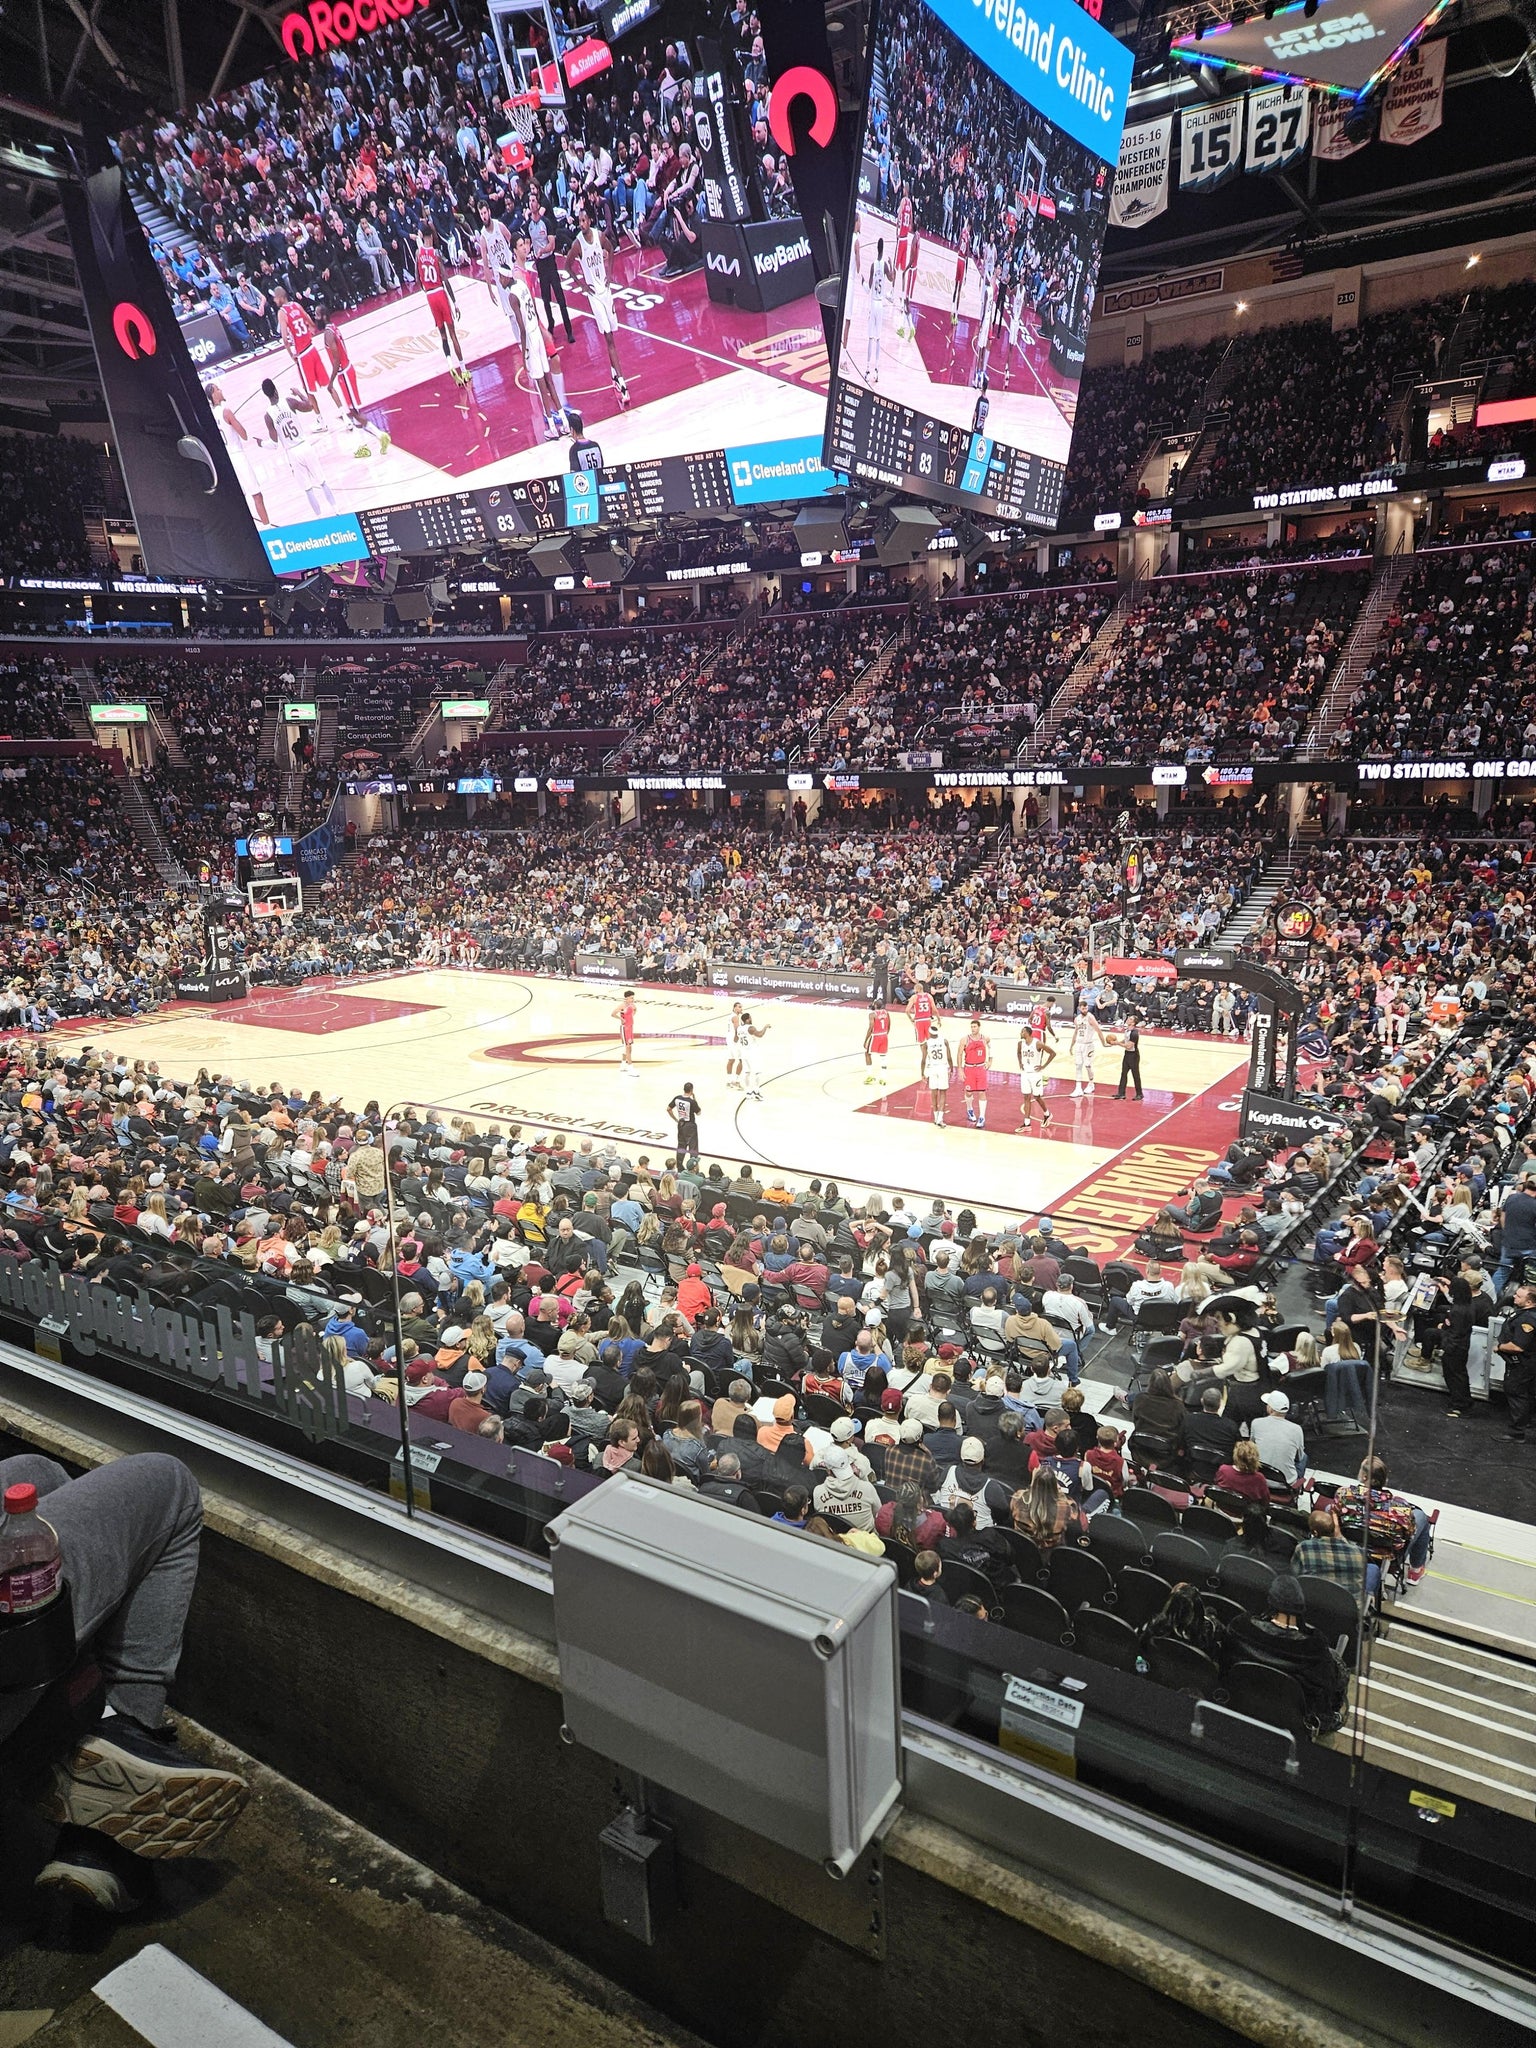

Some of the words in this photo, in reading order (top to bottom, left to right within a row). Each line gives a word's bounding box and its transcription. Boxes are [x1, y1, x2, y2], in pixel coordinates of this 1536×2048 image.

[1264, 23, 1317, 48] LET
[1320, 12, 1370, 36] EM
[1272, 24, 1387, 60] KNOW.
[1056, 36, 1115, 122] Clinic
[1402, 66, 1425, 83] EAST
[1392, 76, 1433, 98] DIVISION
[1385, 88, 1440, 111] CHAMPIONS
[1186, 106, 1238, 130] CALLANDER
[1120, 128, 1162, 150] 2015-16
[1254, 105, 1304, 159] 27
[1120, 146, 1161, 166] WESTERN
[1190, 123, 1232, 174] 15
[714, 101, 735, 175] Cleveland
[727, 174, 744, 217] Clinic
[1114, 173, 1163, 196] CHAMPIONS
[753, 236, 812, 275] KeyBank
[421, 264, 438, 283] 20
[1338, 293, 1355, 304] 210
[292, 318, 308, 338] 33
[1127, 335, 1141, 346] 209
[1420, 386, 1434, 394] 210
[1463, 380, 1477, 388] 211
[281, 420, 300, 442] 45
[939, 429, 949, 445] 3Q
[960, 435, 970, 452] 24
[752, 458, 804, 480] Cleveland
[919, 452, 933, 476] 83
[878, 470, 904, 487] RAFFLE
[943, 467, 957, 486] 1:51
[969, 469, 981, 490] 77
[512, 488, 527, 501] 3Q
[547, 480, 560, 495] 24
[1253, 494, 1279, 509] TWO
[1278, 487, 1338, 507] STATIONS.
[1338, 484, 1362, 499] ONE
[1362, 478, 1399, 497] GOAL.
[572, 502, 591, 521] 77
[497, 514, 515, 532] 83
[534, 513, 555, 530] 1:51
[285, 534, 332, 555] Cleveland
[327, 530, 358, 547] Clinic
[665, 570, 683, 581] TWO
[683, 566, 717, 581] STATIONS.
[716, 564, 732, 577] ONE
[731, 561, 751, 574] GOAL.
[20, 579, 43, 589] LET
[43, 580, 59, 590] EM
[59, 580, 103, 590] KNOW.
[112, 582, 134, 593] TWO
[134, 582, 180, 594] STATIONS.
[461, 582, 478, 592] ONE
[478, 581, 500, 593] GOAL.
[354, 714, 396, 722] Restoration.
[1004, 706, 1015, 714] LOS
[347, 732, 393, 740] Construction.
[934, 773, 958, 787] TWO
[958, 772, 1012, 787] STATIONS.
[1012, 771, 1035, 785] ONE
[1035, 771, 1068, 785] GOAL.
[1357, 763, 1392, 780] TWO
[1392, 762, 1470, 779] STATIONS.
[1472, 761, 1506, 778] ONE
[379, 783, 393, 794] 83
[419, 783, 434, 792] 1:51
[447, 783, 456, 791] 24
[627, 778, 646, 789] TWO
[645, 777, 686, 789] STATIONS.
[685, 777, 702, 789] ONE
[701, 777, 727, 789] GOAL.
[300, 847, 328, 856] COMCAST
[301, 854, 328, 863] BUSINESS
[582, 965, 601, 976] giant
[600, 967, 620, 977] eagle
[1184, 956, 1202, 967] giant
[1202, 957, 1225, 968] eagle
[734, 974, 762, 986] Official
[762, 977, 814, 991] Supermarket
[814, 981, 825, 991] of
[825, 983, 840, 992] the
[840, 983, 860, 994] Cavs
[918, 1002, 929, 1013] 33
[1006, 1001, 1032, 1014] giant
[880, 1018, 886, 1029] 1
[1031, 1015, 1042, 1026] 20
[931, 1049, 944, 1061] 35
[1256, 1028, 1268, 1066] Cleveland
[1254, 1066, 1266, 1089] Clinic
[678, 1101, 686, 1112] 55
[493, 1104, 588, 1128] Rocket
[588, 1120, 670, 1141] Arena
[1248, 1109, 1309, 1129] KeyBank
[1027, 1143, 1221, 1254] CAVALIERS
[823, 1503, 863, 1514] CAVALIERS
[1013, 1682, 1056, 1703] Production
[1057, 1698, 1077, 1711] Date
